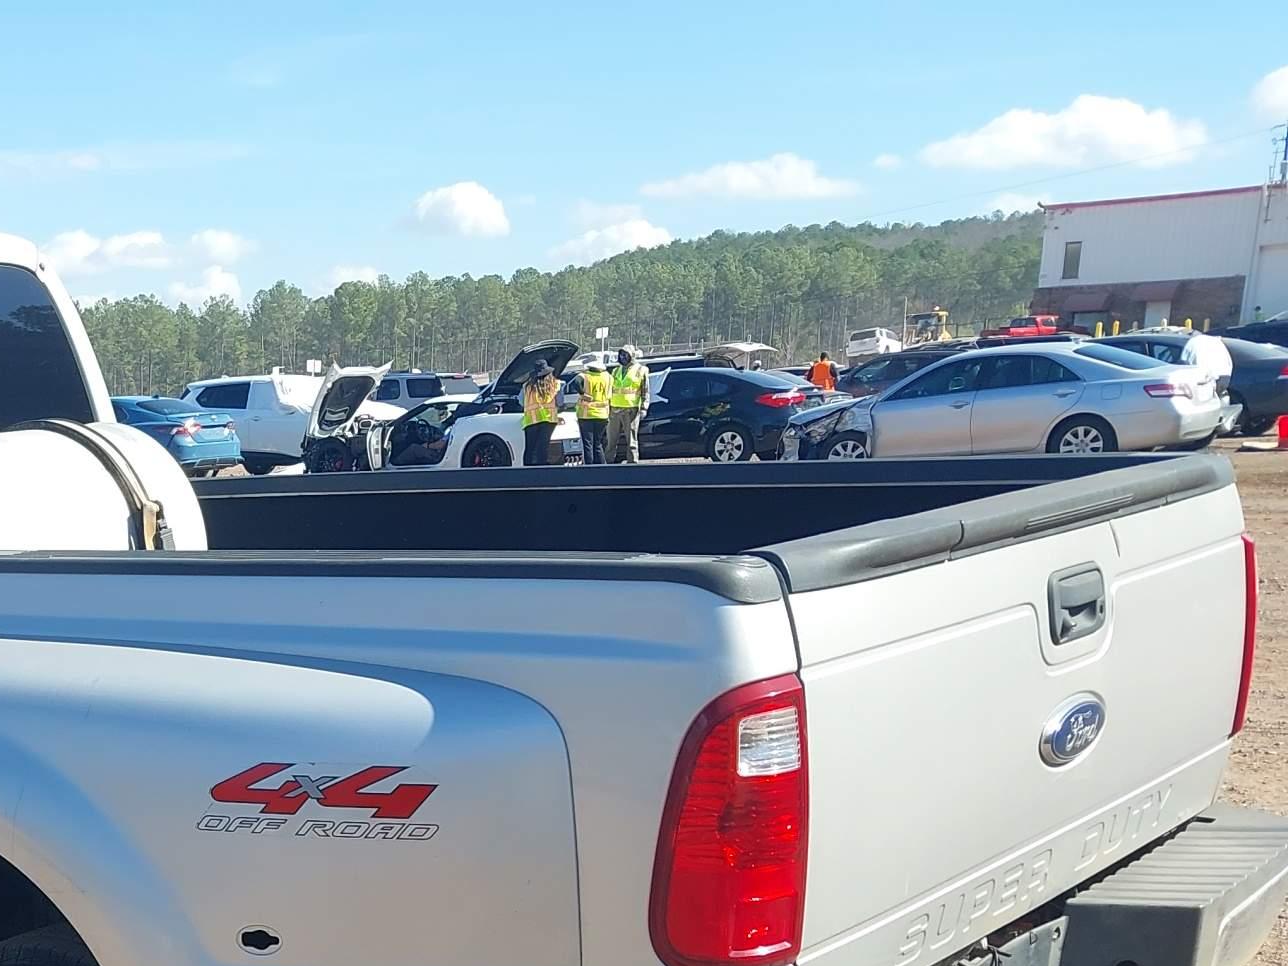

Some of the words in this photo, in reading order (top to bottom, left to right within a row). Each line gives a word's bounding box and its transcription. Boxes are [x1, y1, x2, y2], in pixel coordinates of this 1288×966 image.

[1065, 709, 1100, 752] Ford
[196, 815, 289, 835] OFF
[294, 819, 440, 841] ROAD
[1073, 783, 1174, 872] DUTY
